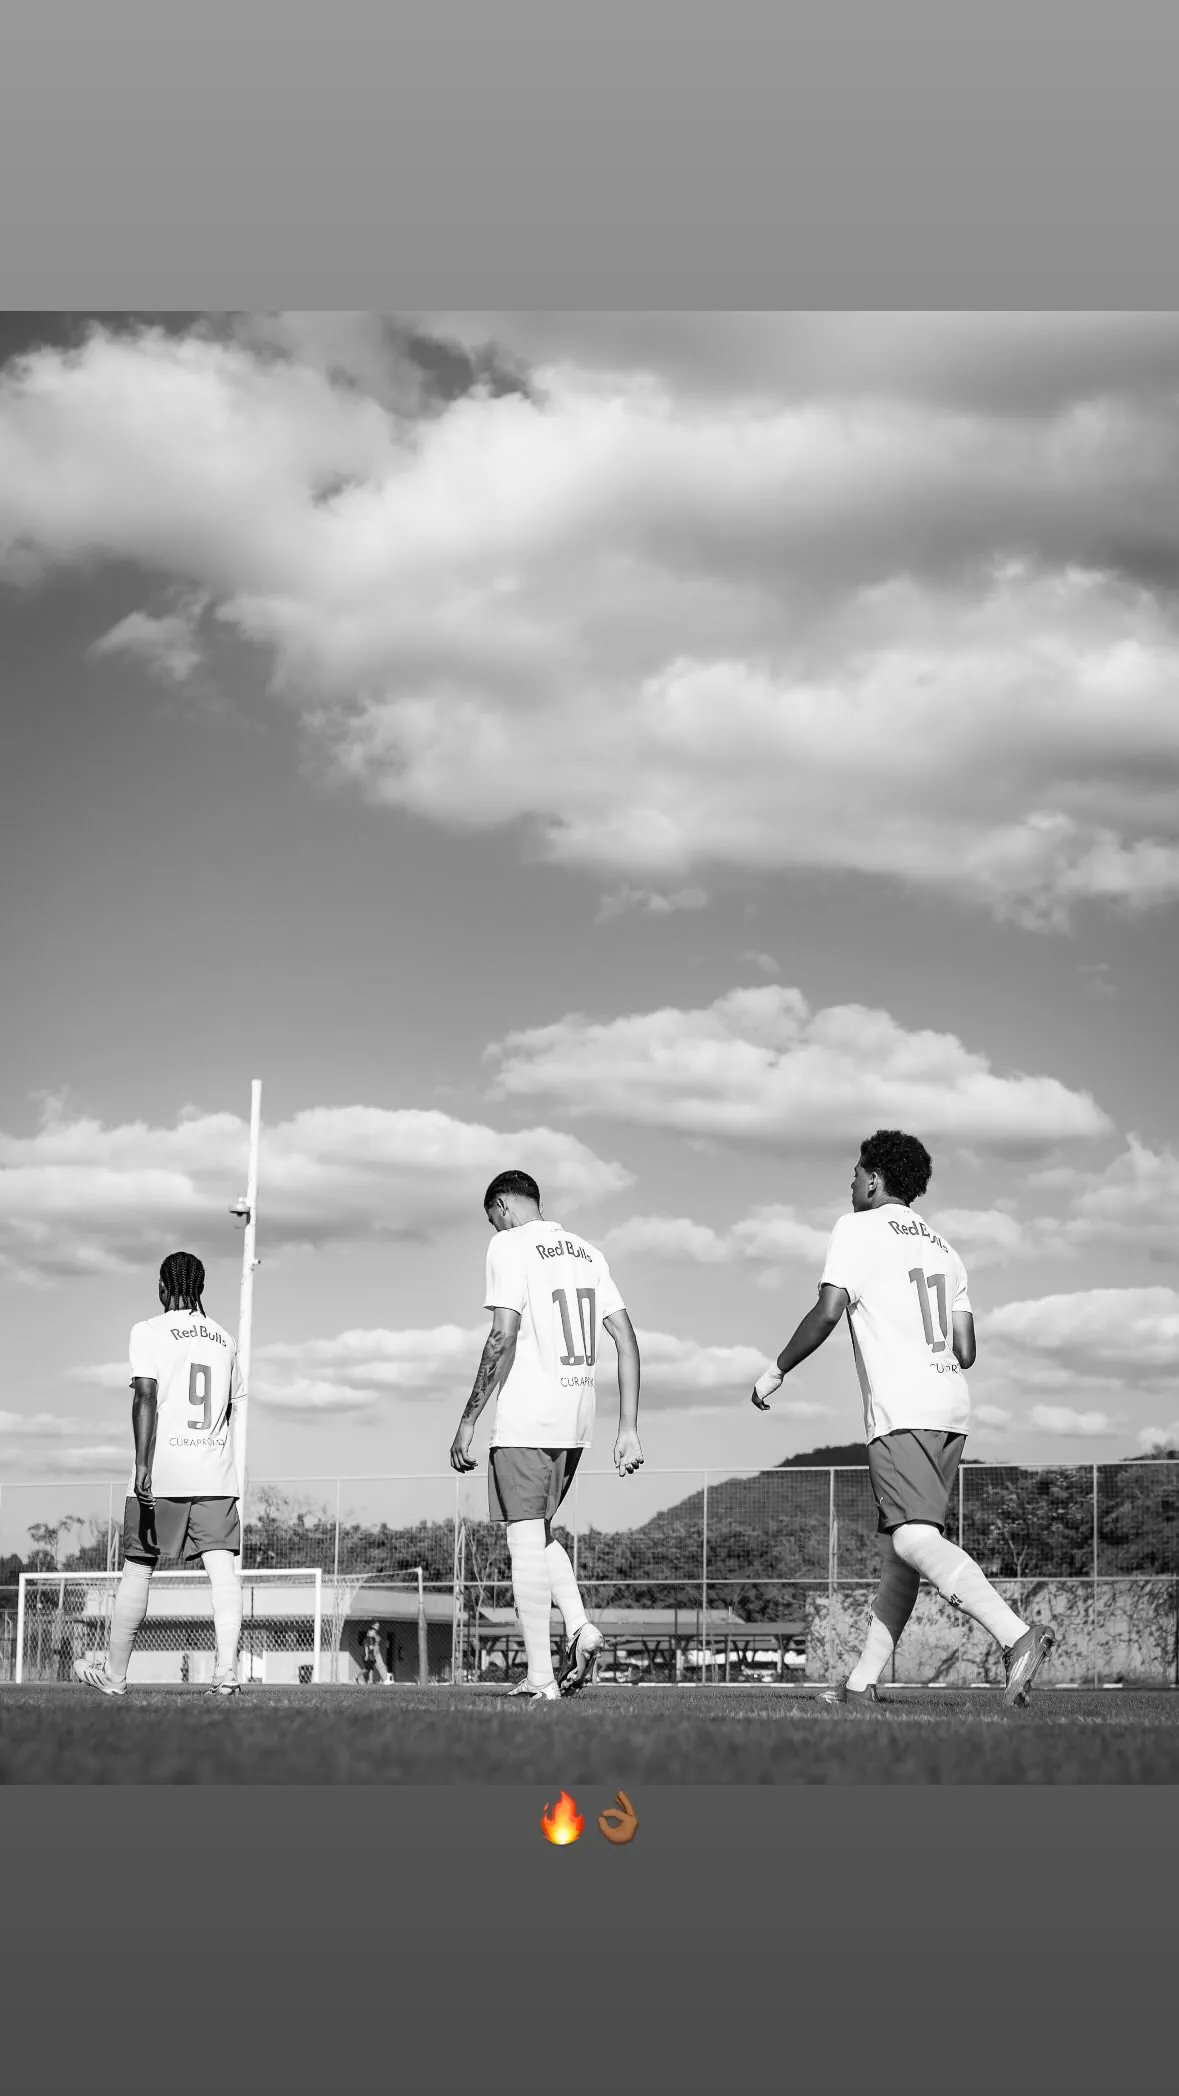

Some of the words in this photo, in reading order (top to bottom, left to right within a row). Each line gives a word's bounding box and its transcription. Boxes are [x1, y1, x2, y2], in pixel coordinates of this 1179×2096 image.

[888, 1220, 919, 1235] Red
[536, 1240, 564, 1260] Red
[565, 1240, 593, 1263] Bulls
[551, 1287, 596, 1366] 10
[908, 1267, 948, 1354] 11
[170, 1324, 199, 1341] Red
[199, 1325, 227, 1347] Bulls
[187, 1362, 212, 1430] 9
